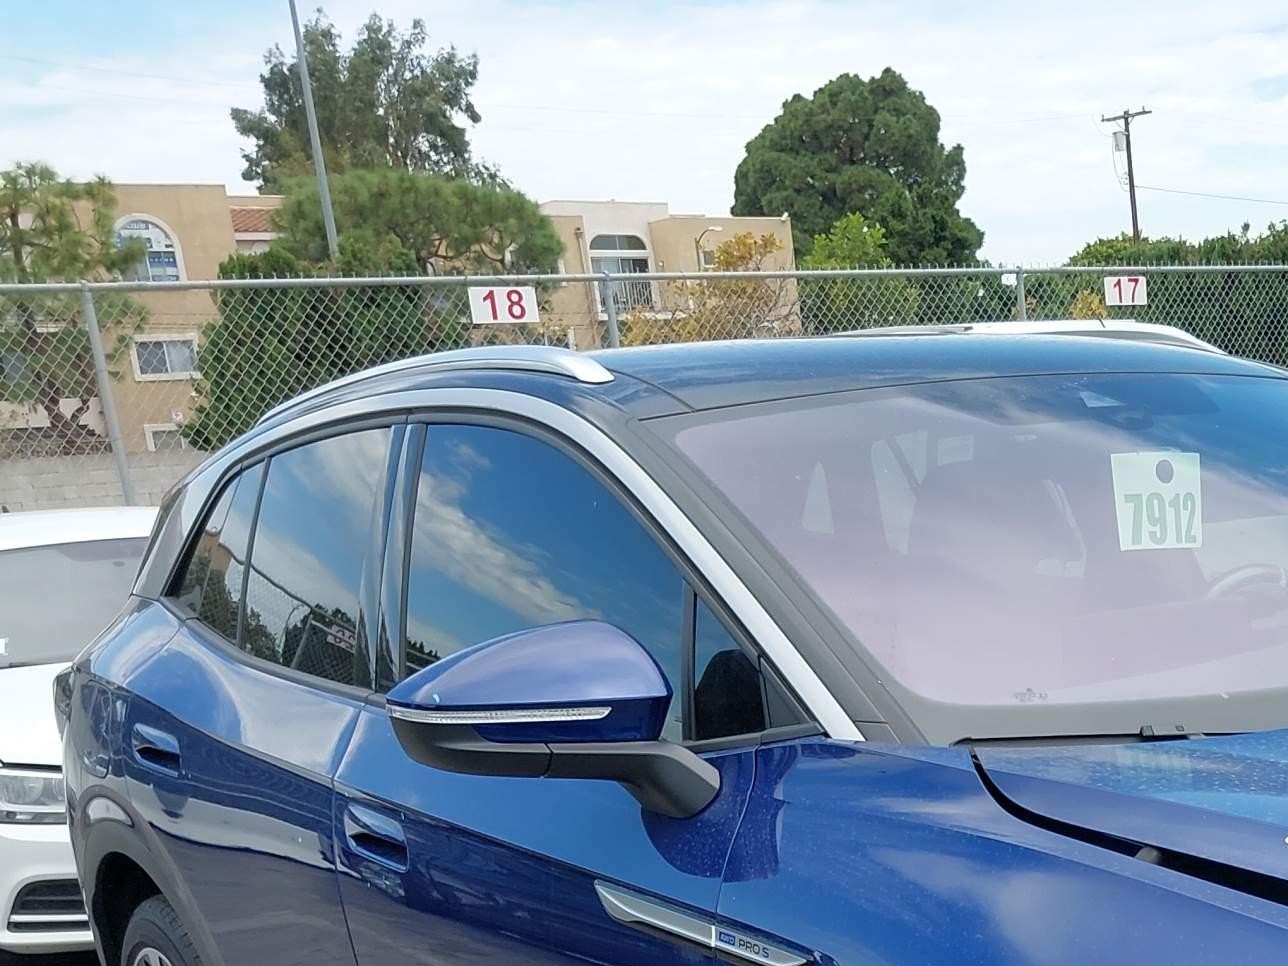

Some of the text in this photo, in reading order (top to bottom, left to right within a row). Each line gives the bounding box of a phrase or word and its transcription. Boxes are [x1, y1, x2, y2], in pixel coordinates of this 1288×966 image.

[482, 289, 527, 321] 18
[1113, 278, 1139, 304] 17
[1123, 491, 1197, 545] 7912
[738, 938, 761, 955] PRO
[762, 947, 770, 959] S
